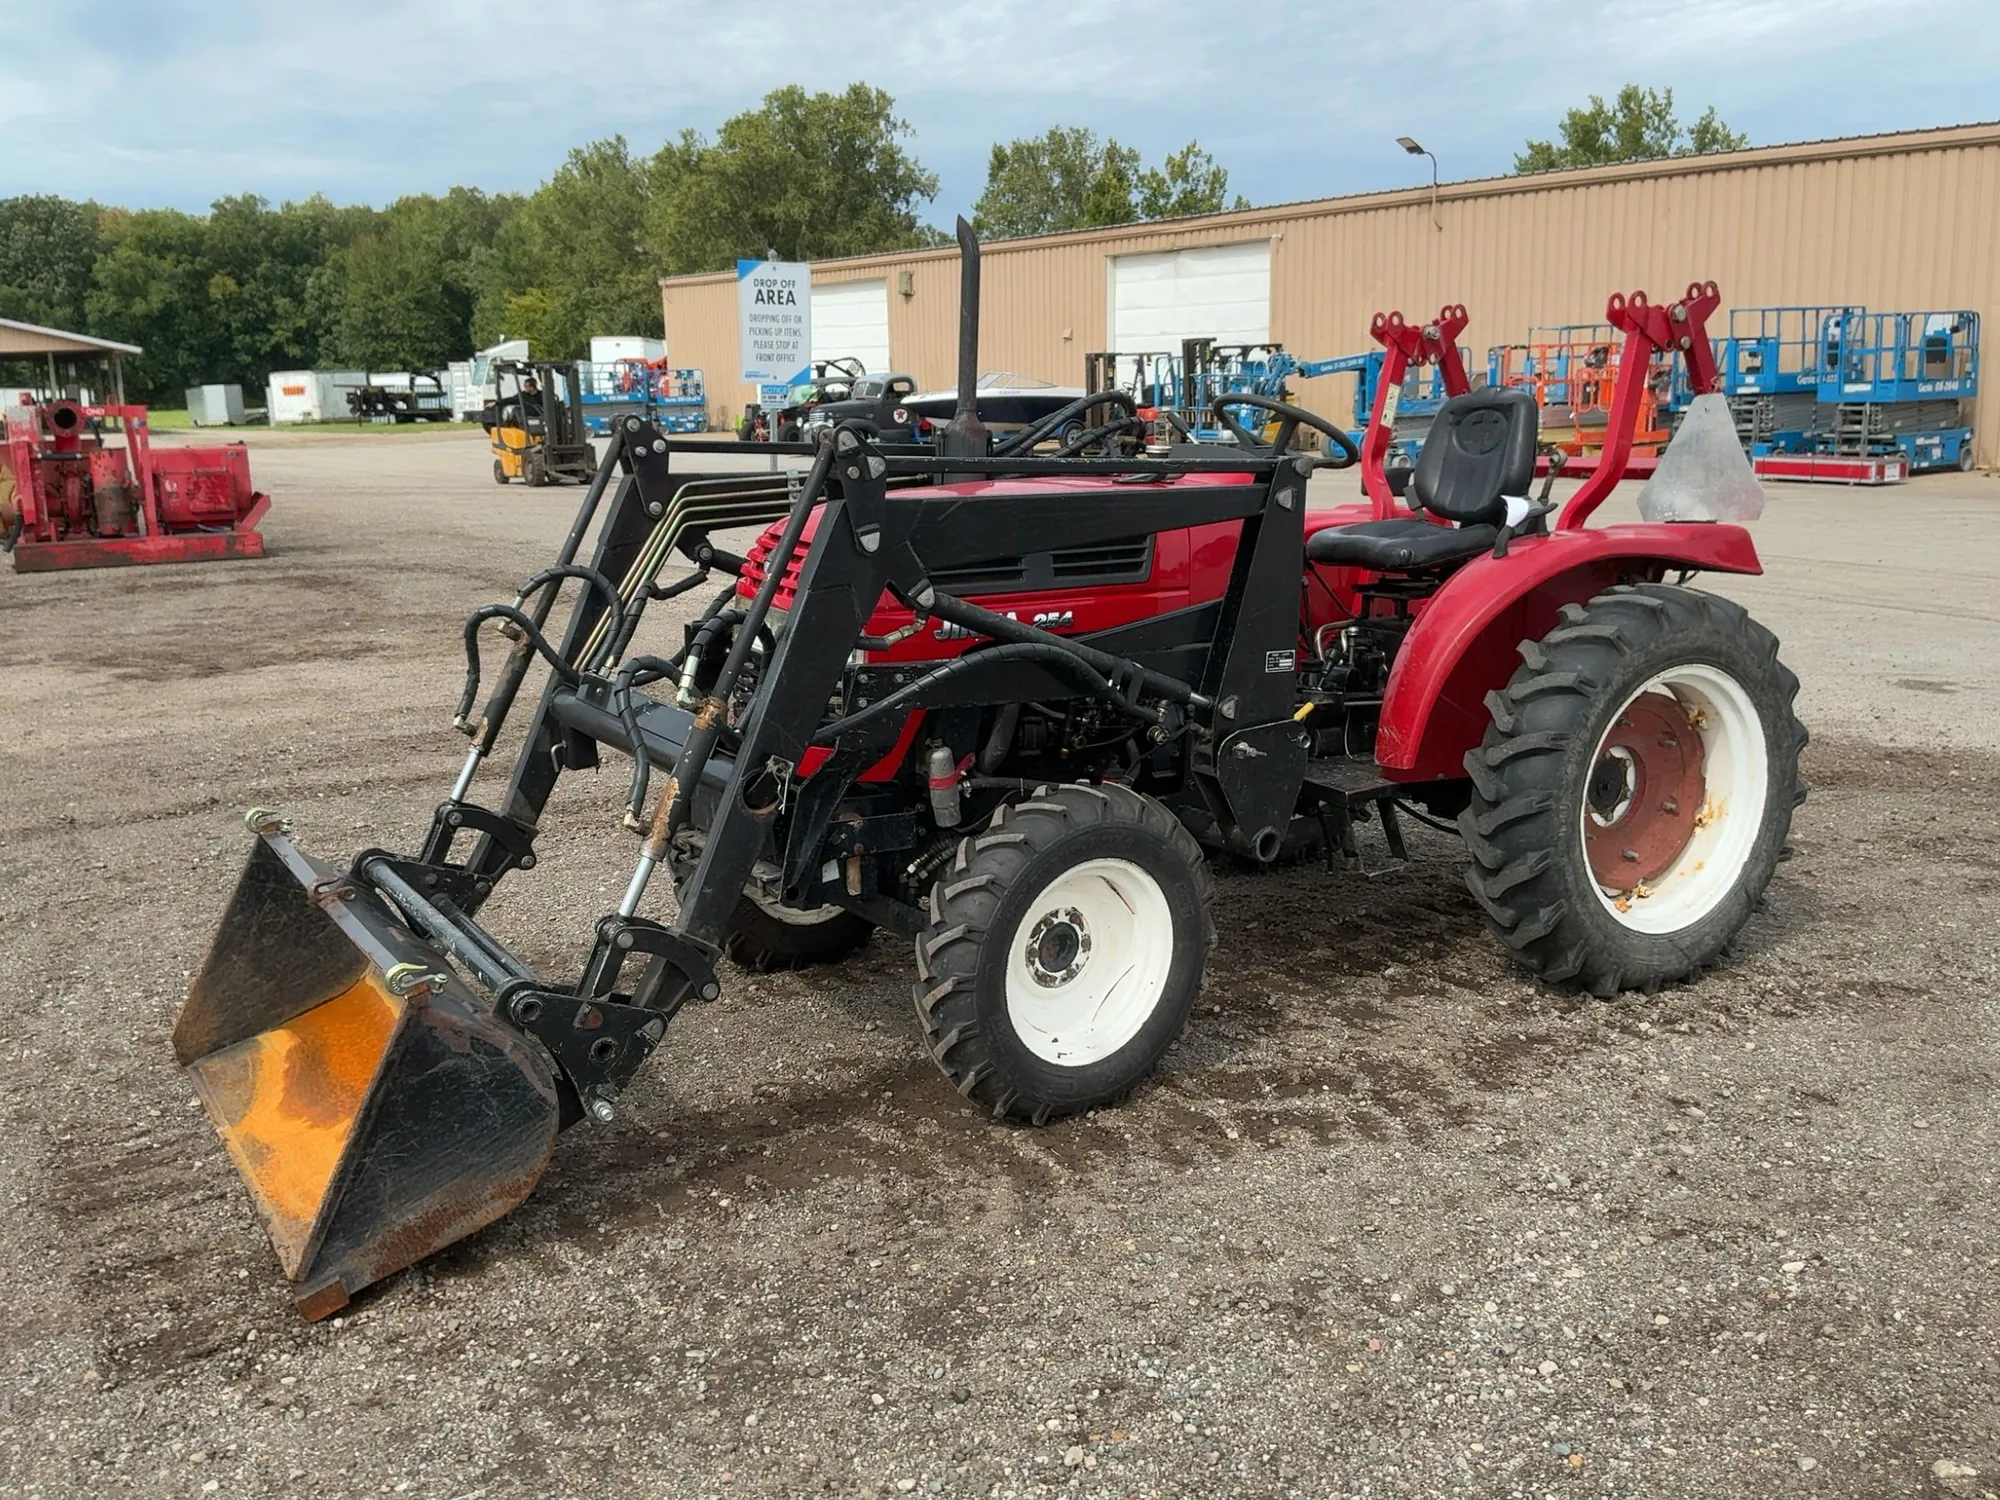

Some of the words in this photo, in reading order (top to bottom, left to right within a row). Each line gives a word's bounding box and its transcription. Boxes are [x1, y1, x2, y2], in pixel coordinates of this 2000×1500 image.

[754, 278, 778, 288] DROP
[780, 280, 796, 288] OFF
[755, 289, 796, 306] AREA
[749, 314, 780, 324] DROPPING
[782, 314, 792, 324] OFF
[794, 315, 802, 324] OR
[748, 326, 773, 336] PICKING
[774, 328, 783, 337] UP
[754, 340, 774, 349] PLEASE
[776, 340, 790, 350] STOP
[792, 341, 799, 350] AT
[756, 353, 774, 362] FRONT
[776, 354, 796, 362] OFFICE
[1918, 383, 1932, 393] Genie
[1033, 611, 1073, 628] 254
